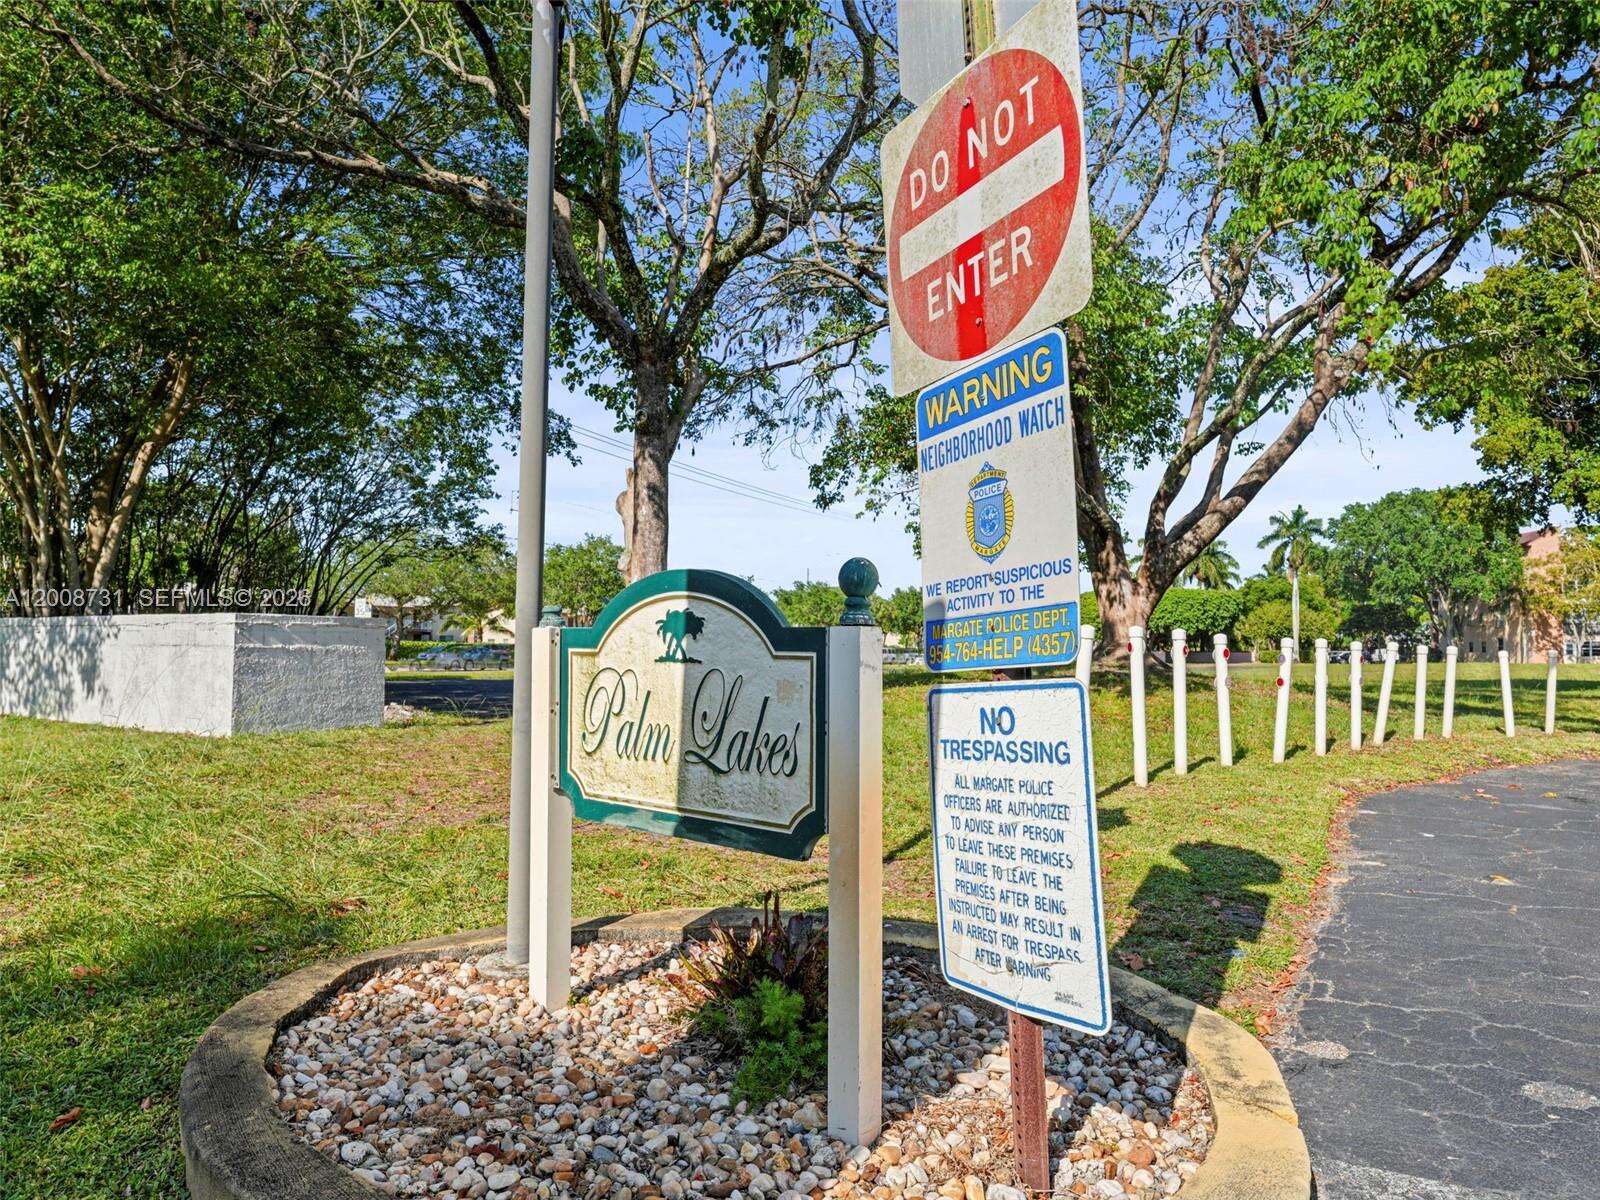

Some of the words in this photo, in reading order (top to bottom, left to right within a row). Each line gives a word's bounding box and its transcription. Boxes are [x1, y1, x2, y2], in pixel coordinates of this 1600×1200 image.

[910, 150, 950, 212] DO
[967, 76, 1039, 169] NOT
[928, 225, 1033, 322] ENTER
[925, 346, 1053, 429] WARNING
[921, 416, 1012, 473] NEIGHBORHOOD
[1019, 396, 1065, 438] WATCH
[974, 483, 1002, 499] POLICE
[926, 583, 941, 598] WE
[946, 574, 988, 594] REPORT
[993, 558, 1072, 586] SUSPICIOUS
[946, 592, 994, 612] ACTIVITY
[999, 588, 1015, 604] TO
[1020, 584, 1045, 600] THE
[933, 619, 983, 640] MARGATE
[986, 613, 1030, 634] POLICE
[1034, 608, 1070, 629] DEPT.
[930, 636, 1024, 664] 954-764-HELP
[1028, 631, 1076, 656] (4357)
[581, 667, 676, 765] Palm
[685, 668, 801, 777] Lakes
[980, 706, 1015, 735] NO
[940, 739, 1071, 765] TRESPASSING
[955, 774, 970, 790] ALL
[973, 776, 1014, 793] MARGATE
[1019, 780, 1053, 796] POLICE
[944, 794, 981, 812] OFFICERS
[985, 799, 1002, 815] ARE
[951, 815, 961, 830] TO
[964, 818, 994, 835] ADVISE
[998, 821, 1018, 838] ANY
[1023, 824, 1064, 843] PERSON
[945, 835, 955, 850] TO
[958, 837, 984, 855] LEAVE
[987, 842, 1016, 861] THESE
[1021, 847, 1073, 869] PREMISES
[955, 858, 988, 877] FAILURE
[992, 864, 1003, 880] TO
[1006, 867, 1037, 888] LEAVE
[1043, 873, 1063, 892] THE
[955, 878, 995, 901] PREMISES
[1000, 889, 1029, 909] AFTER
[1035, 896, 1067, 916] BEING
[949, 898, 996, 923] INSTRUCTED
[1000, 911, 1019, 929] MAY
[1024, 917, 1063, 938] RESULT
[1070, 926, 1081, 943] IN
[952, 919, 963, 935] AN
[966, 922, 997, 945] ARREST
[1002, 933, 1019, 951] FOR
[1024, 939, 1081, 964] TRESPASS
[975, 947, 1001, 968] AFTER
